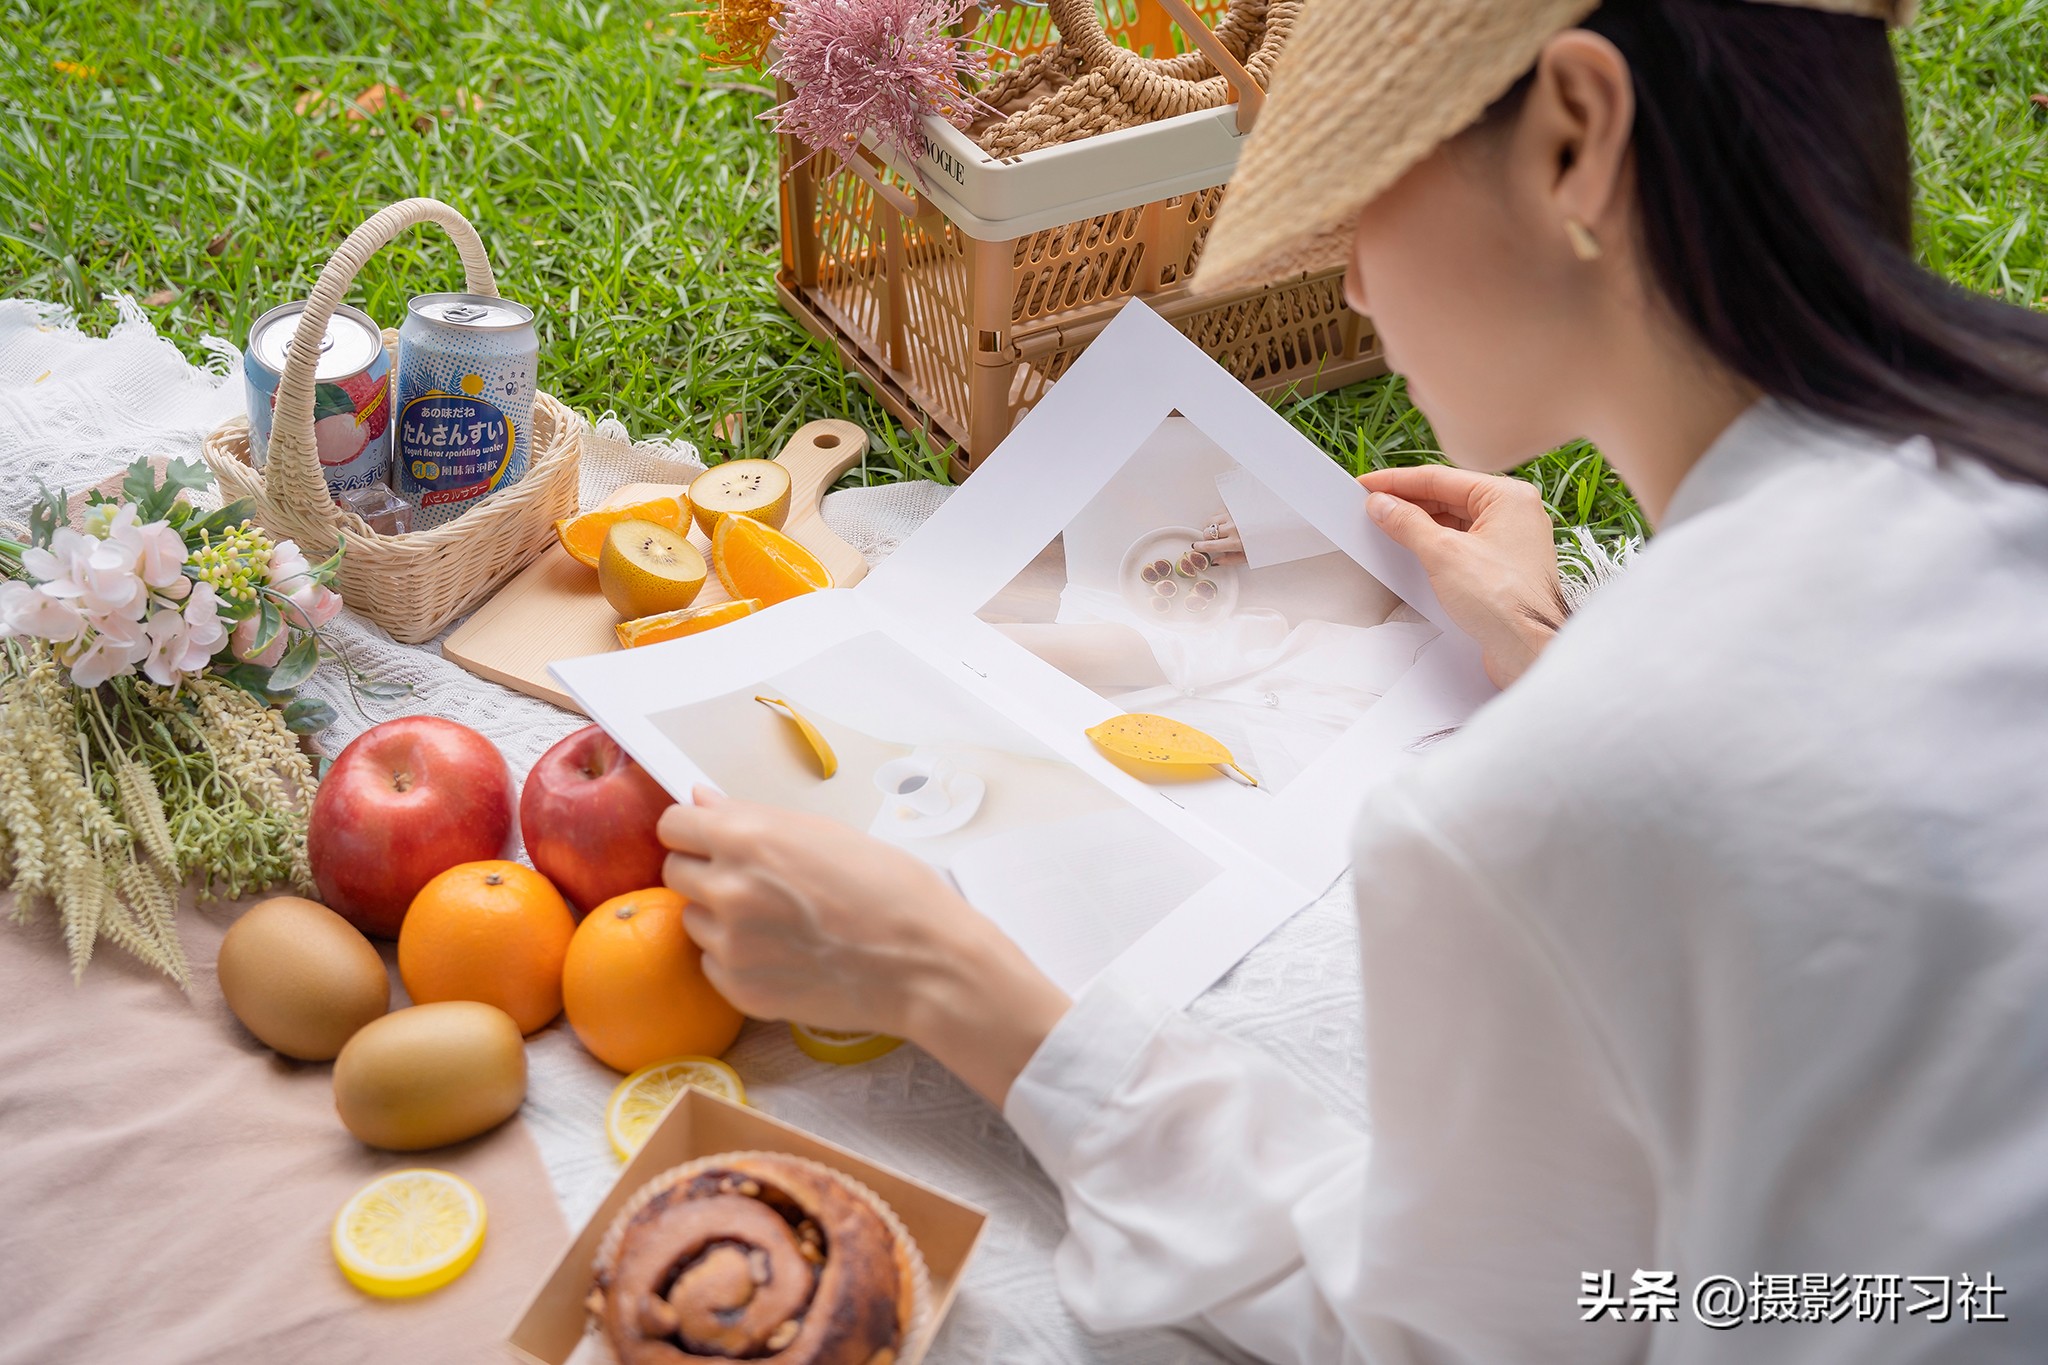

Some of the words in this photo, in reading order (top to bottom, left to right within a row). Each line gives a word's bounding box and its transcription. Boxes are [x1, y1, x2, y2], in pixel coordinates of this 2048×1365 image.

[924, 135, 965, 185] VOGUE
[421, 407, 476, 419] あの味だね
[403, 420, 504, 446] たんさんすい
[404, 446, 422, 457] Yogurt
[423, 448, 444, 458] flavor
[445, 447, 481, 460] sparkling
[482, 443, 504, 454] water
